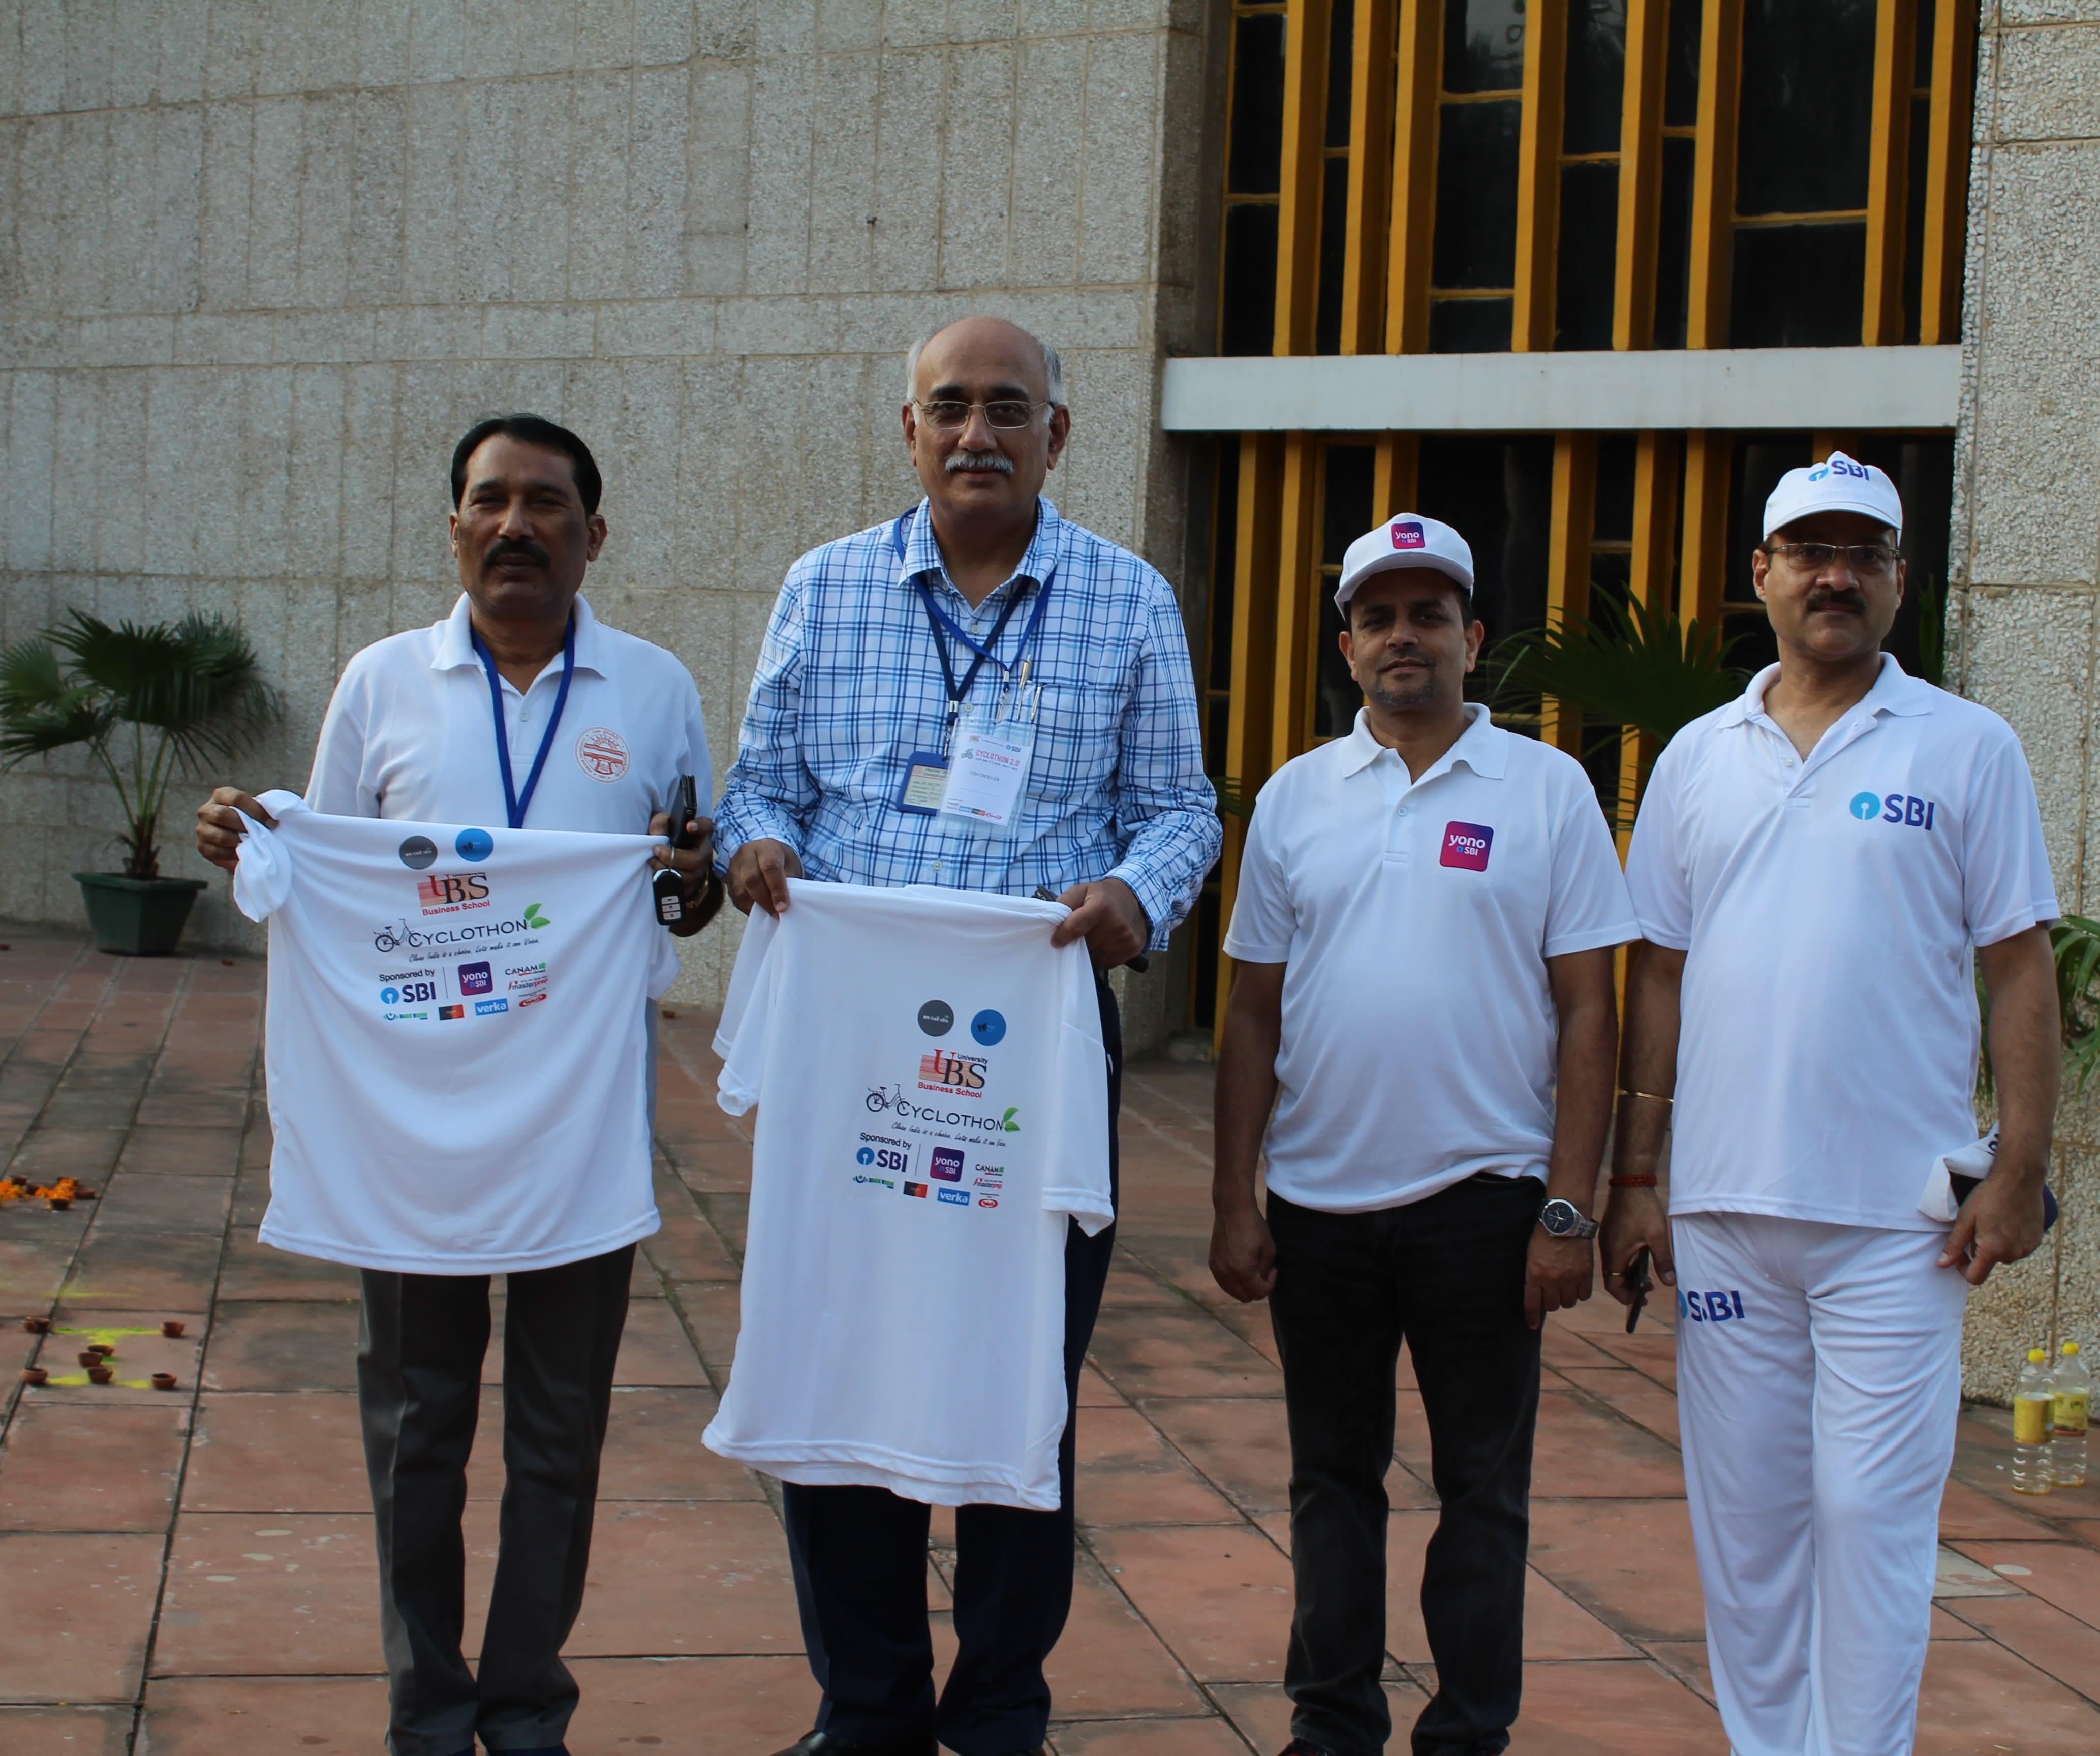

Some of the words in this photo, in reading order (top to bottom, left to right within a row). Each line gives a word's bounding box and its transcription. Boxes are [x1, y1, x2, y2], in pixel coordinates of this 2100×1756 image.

[1831, 460, 1870, 481] SBI
[1395, 531, 1419, 539] yono
[976, 750, 1009, 764] CYCLOTHON
[1009, 758, 1020, 766] 2.0
[1882, 794, 1934, 831] SBI
[1448, 834, 1486, 849] yono
[1464, 846, 1478, 856] SBI
[427, 874, 489, 904] UBS
[422, 906, 460, 915] Business
[462, 900, 490, 910] School
[409, 919, 528, 947] CYCLOTHON
[379, 969, 423, 982] Sponsored
[424, 969, 435, 977] by
[462, 972, 488, 983] yono
[505, 965, 538, 975] CANAM
[402, 982, 436, 1003] SBI
[477, 1002, 507, 1013] verka
[957, 1053, 988, 1064] University
[934, 1049, 987, 1089] UBS
[918, 1082, 953, 1094] Business
[955, 1088, 982, 1098] School
[897, 1101, 1003, 1131] CYCLOTHON
[859, 1132, 901, 1147] Sponsored
[903, 1140, 912, 1150] by
[876, 1149, 908, 1172] SBI
[935, 1157, 960, 1167] yono
[975, 1164, 999, 1173] CANAM
[940, 1192, 968, 1203] verka
[1687, 1290, 1745, 1322] SBI
